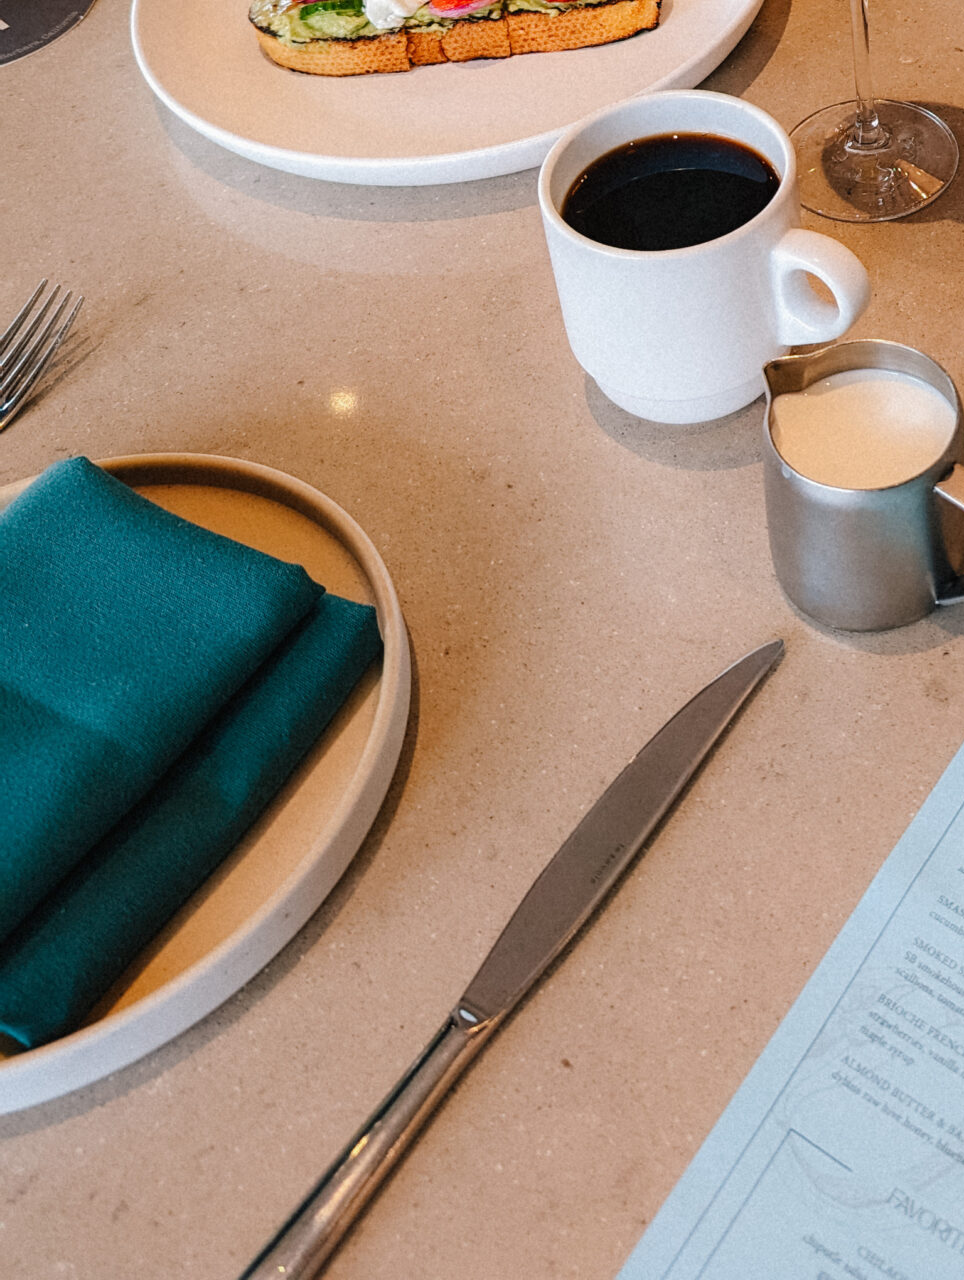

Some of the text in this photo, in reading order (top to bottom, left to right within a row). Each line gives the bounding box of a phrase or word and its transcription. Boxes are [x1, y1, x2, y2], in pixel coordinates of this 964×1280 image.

[902, 949, 919, 965] SB
[910, 934, 960, 971] SMOKED
[876, 992, 929, 1032] BRIOCHE
[857, 1024, 889, 1049] maple
[839, 1053, 893, 1093] ALMOND
[889, 1085, 937, 1122] BUTTER
